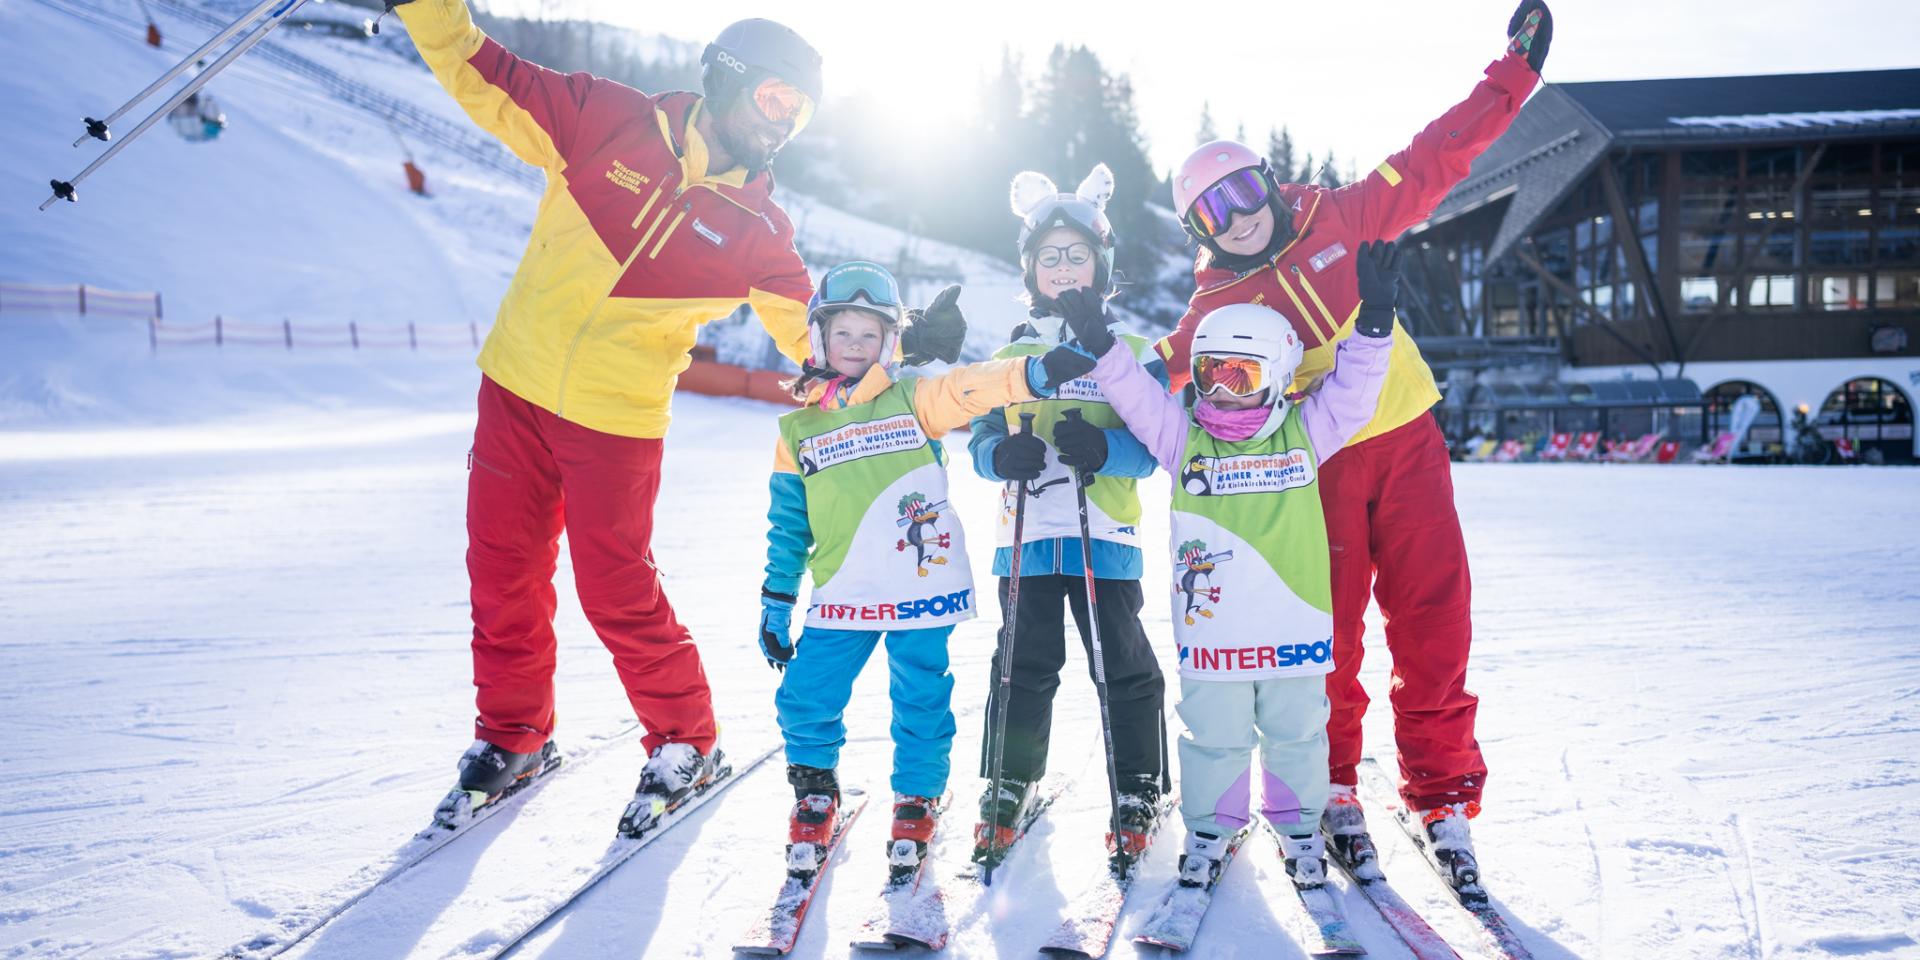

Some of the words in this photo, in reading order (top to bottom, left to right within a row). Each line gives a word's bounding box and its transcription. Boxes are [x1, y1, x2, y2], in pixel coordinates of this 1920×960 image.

[818, 440, 854, 457] KRAINER
[864, 429, 917, 444] WULSCHNIG
[820, 456, 831, 464] Bad
[820, 589, 970, 620] INTERSPORT
